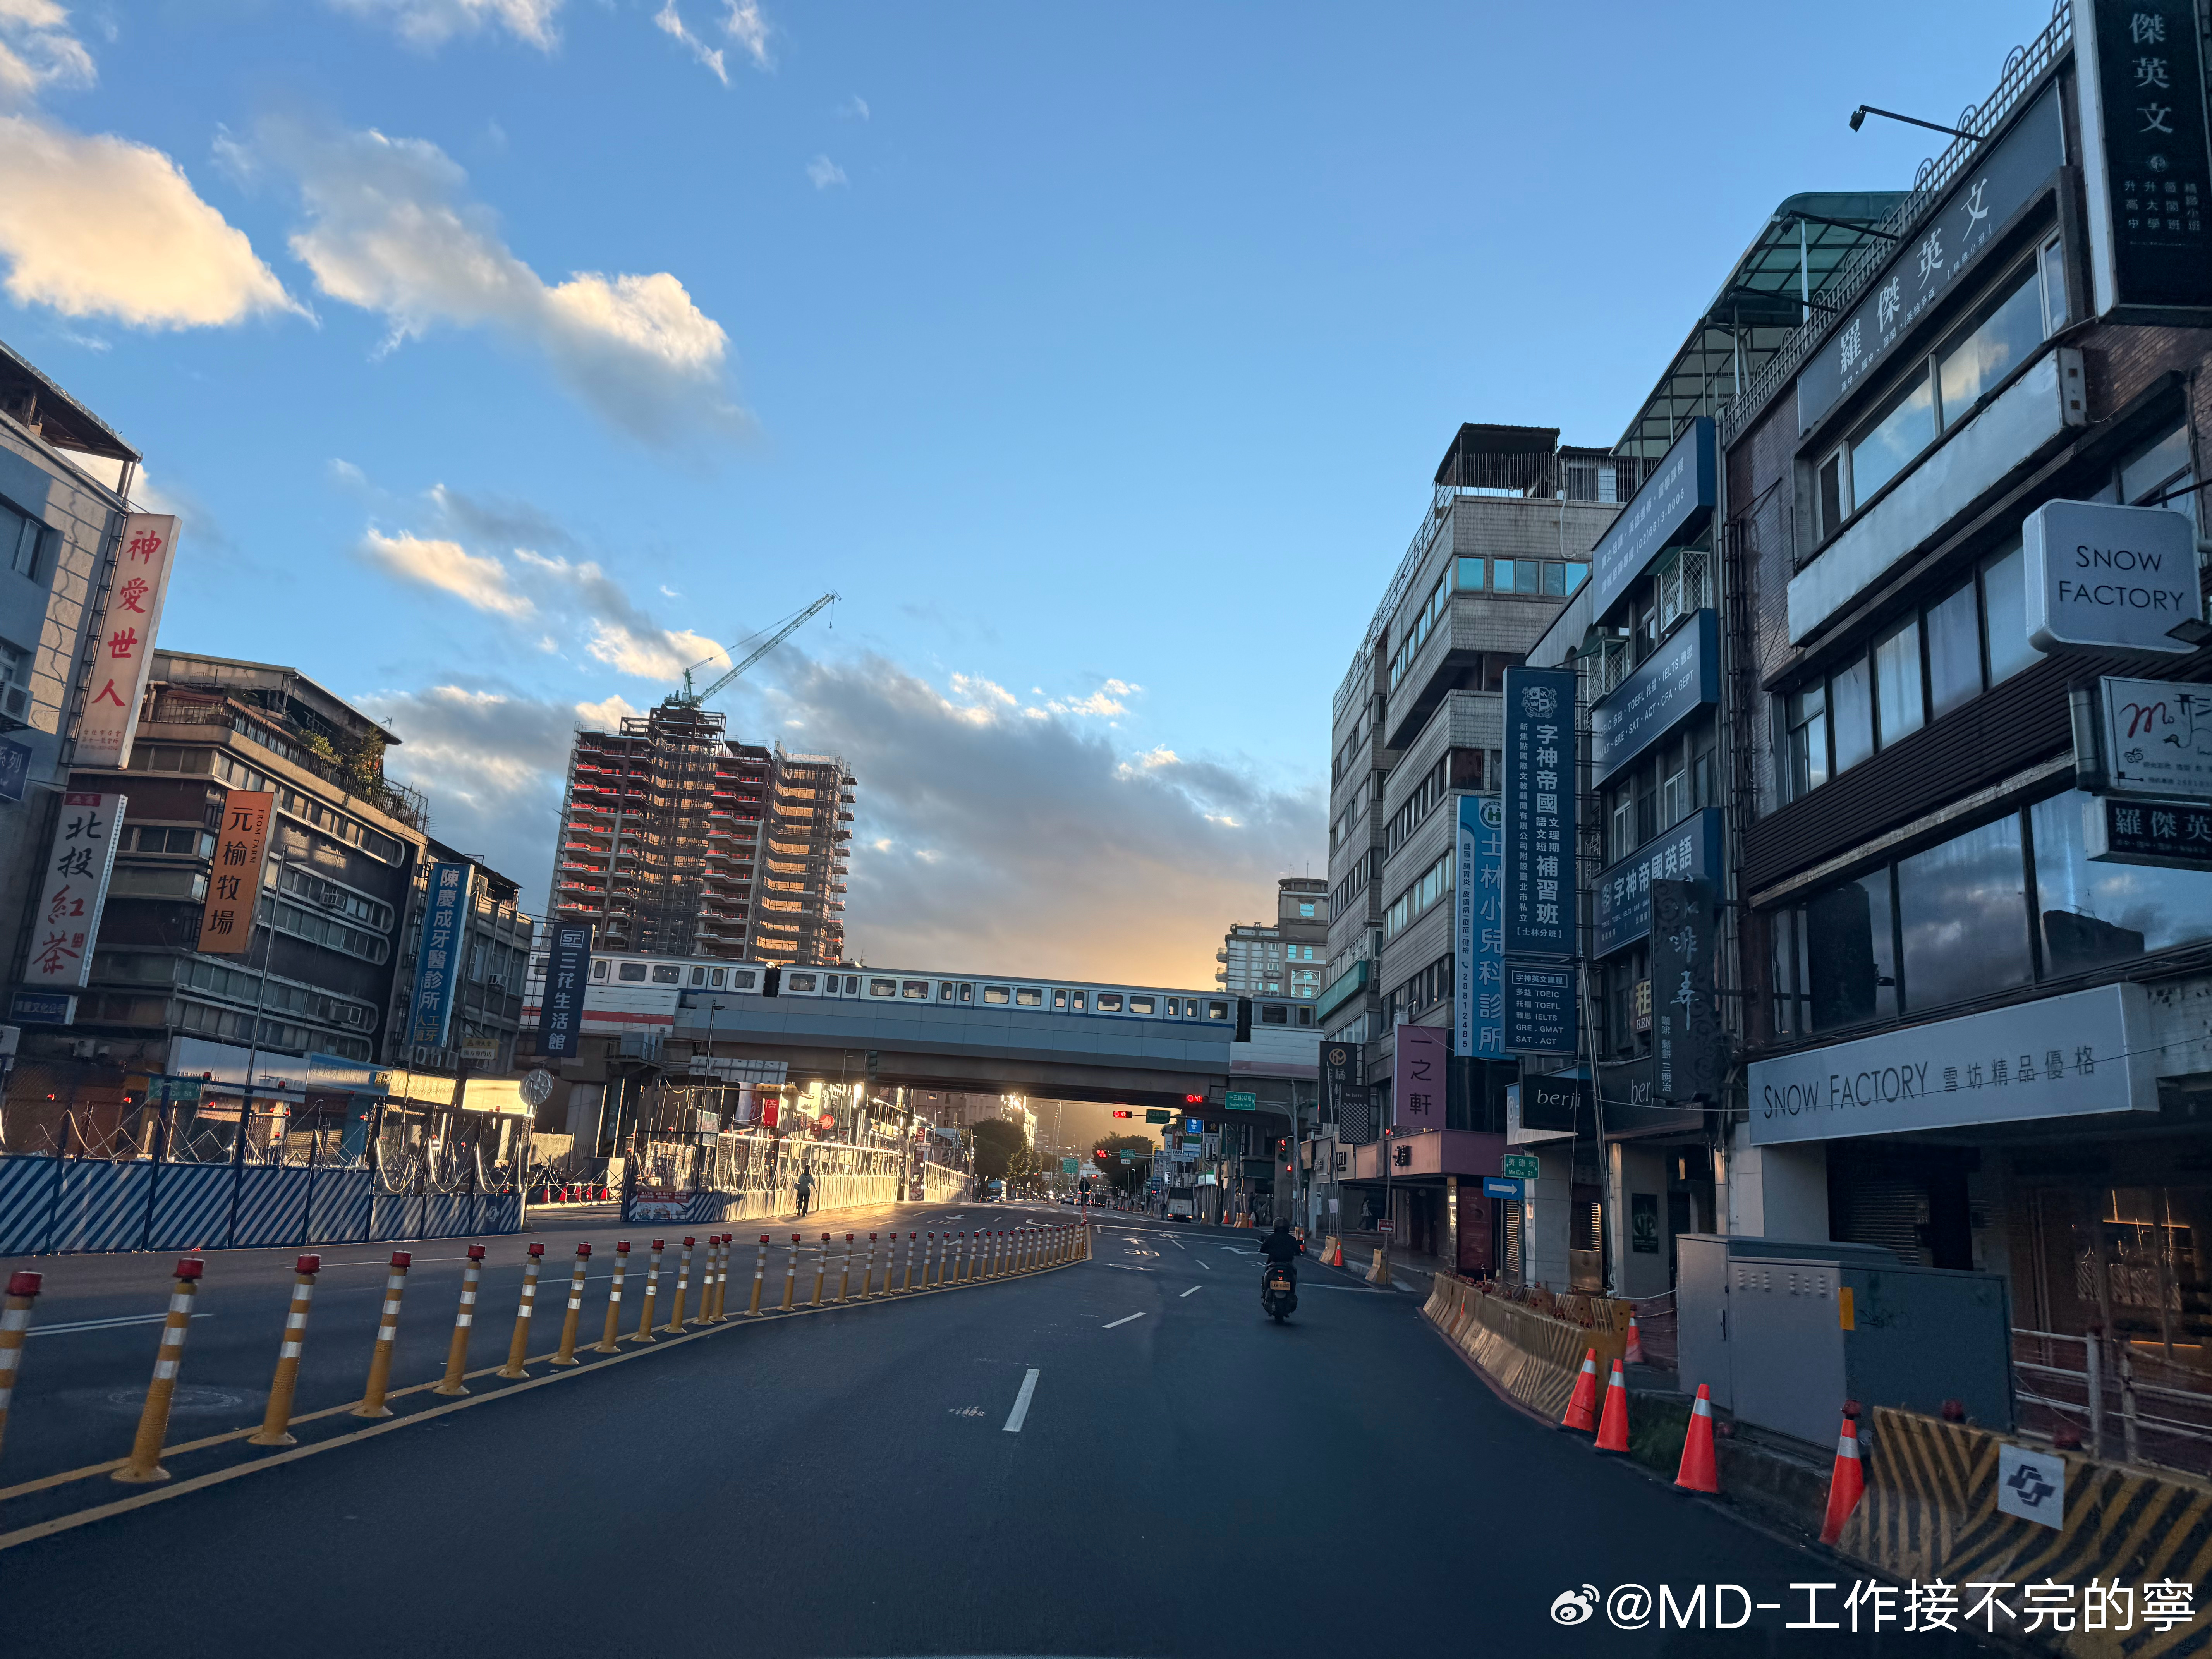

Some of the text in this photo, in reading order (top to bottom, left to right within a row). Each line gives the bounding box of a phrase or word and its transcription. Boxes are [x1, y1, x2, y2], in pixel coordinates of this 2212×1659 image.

[2128, 13, 2174, 134] 傑英文
[1841, 178, 1989, 375] 羅傑英文
[2076, 545, 2162, 572] SNOW
[91, 530, 162, 707] 神愛世人
[2059, 580, 2185, 611] FACTORY
[1614, 730, 1624, 747] GRE
[1629, 717, 1640, 735] SAT
[1645, 702, 1656, 721] ACT
[1661, 689, 1673, 706] CFA
[1678, 669, 1694, 691] GEPT
[1628, 691, 1644, 713] TOEFL
[1662, 658, 1679, 681] IELTS
[208, 807, 253, 936] 元榆牧場
[249, 809, 265, 864] FROM FARM
[1614, 835, 1692, 907] 字神帝國英語
[33, 811, 103, 975] 北投紅茶
[420, 869, 460, 1011] 陳慶成牙醫診所
[1479, 833, 1502, 1052] 士林小兒科診所
[548, 952, 578, 1051] 三花生活館
[1516, 988, 1531, 997] 多益
[1535, 1002, 1561, 1010] TOEFL
[1635, 980, 1651, 1017] 租
[1637, 1016, 1652, 1030] REN
[1540, 1026, 1564, 1034] GMAT
[1410, 1039, 1432, 1116] 一之軒
[1537, 1089, 1581, 1110] berji
[1764, 1045, 2095, 1120] SNOW FACTORY 雪坊精品優格
[1122, 1248, 1160, 1257] 30
